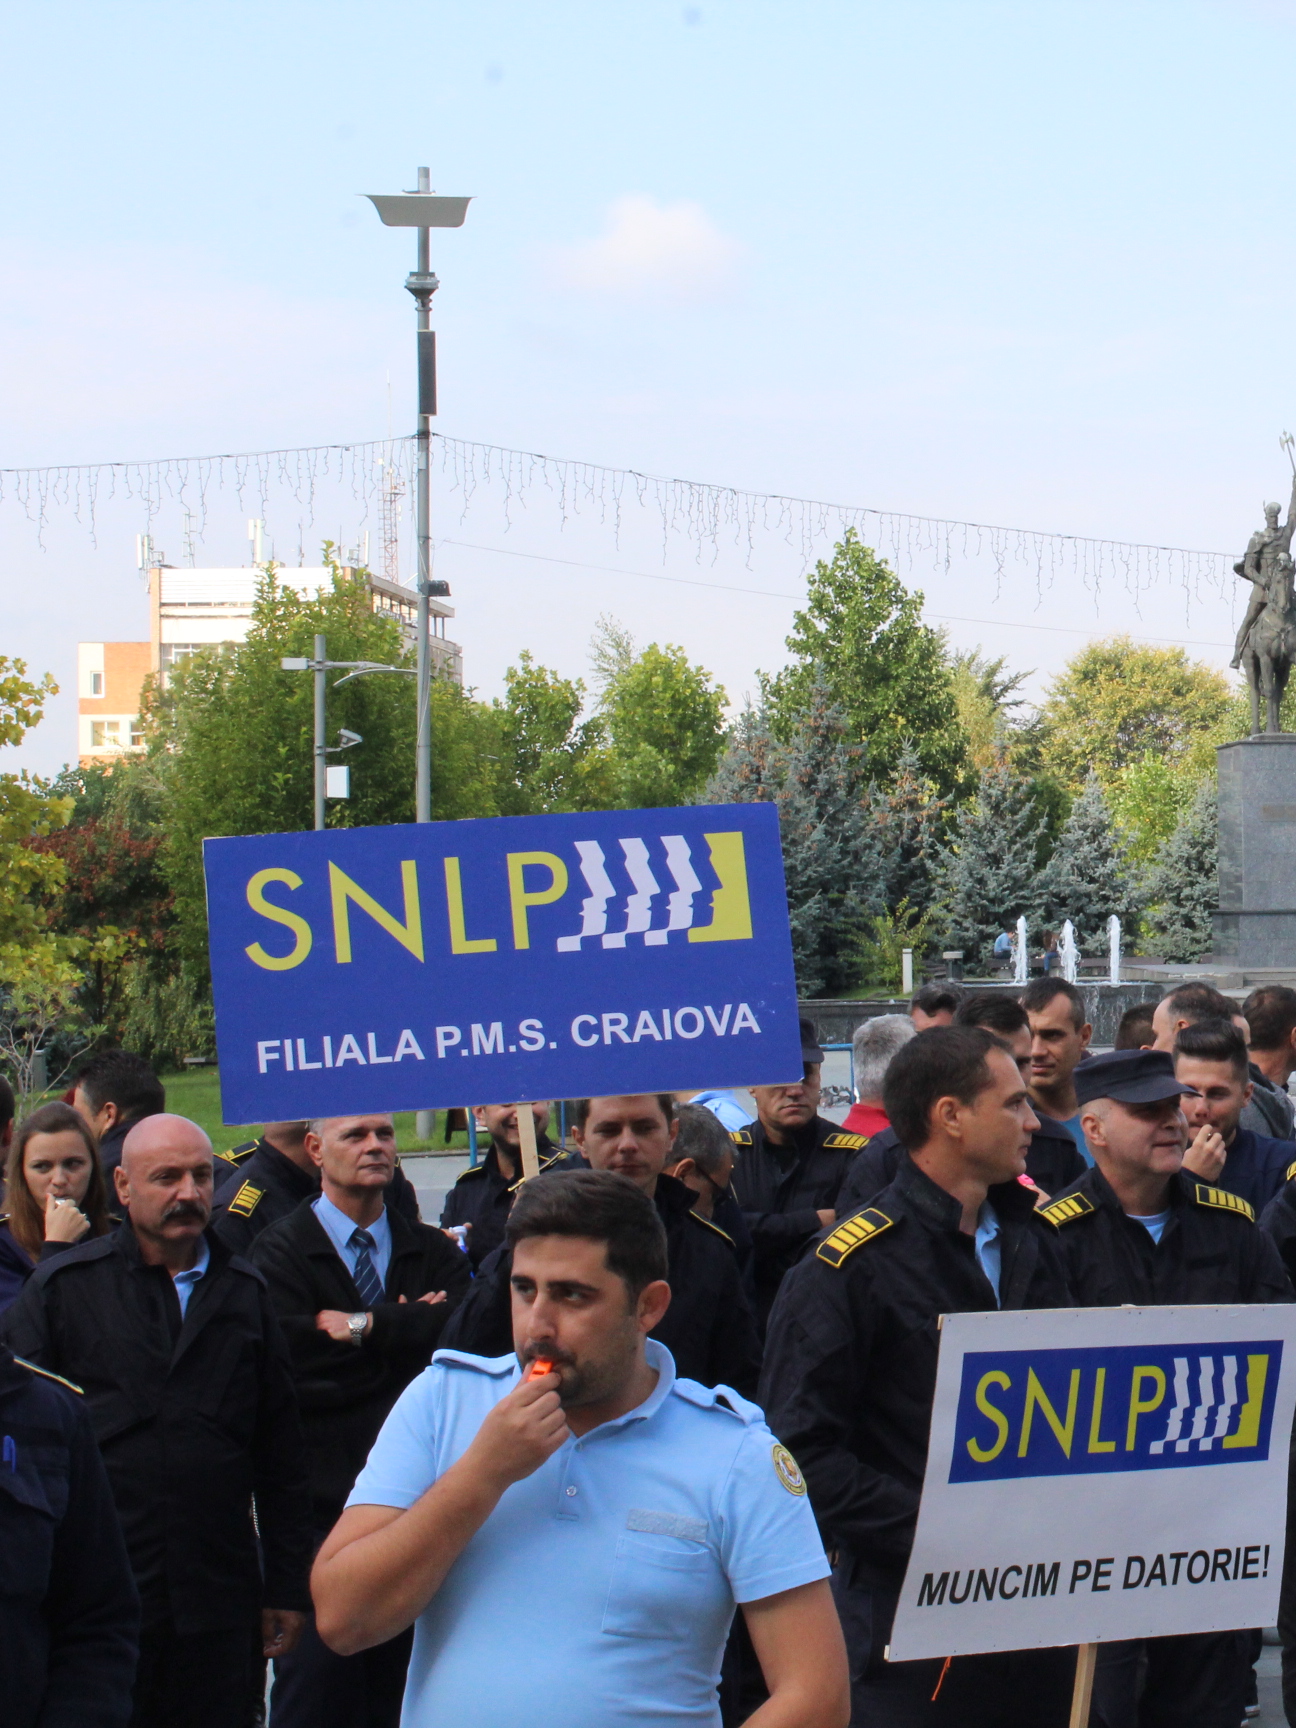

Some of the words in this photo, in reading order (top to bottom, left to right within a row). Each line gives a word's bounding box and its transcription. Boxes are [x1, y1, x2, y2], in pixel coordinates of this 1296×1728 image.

[244, 850, 569, 971] SNLP
[256, 1028, 426, 1074] FILIALA
[436, 1018, 557, 1059] P.M.S.
[570, 1002, 762, 1048] CRAIOVA
[966, 1365, 1167, 1463] SNLP
[916, 1561, 1061, 1607] MUNCIM
[1068, 1557, 1115, 1594] PE
[1122, 1544, 1271, 1589] DATORIE!
